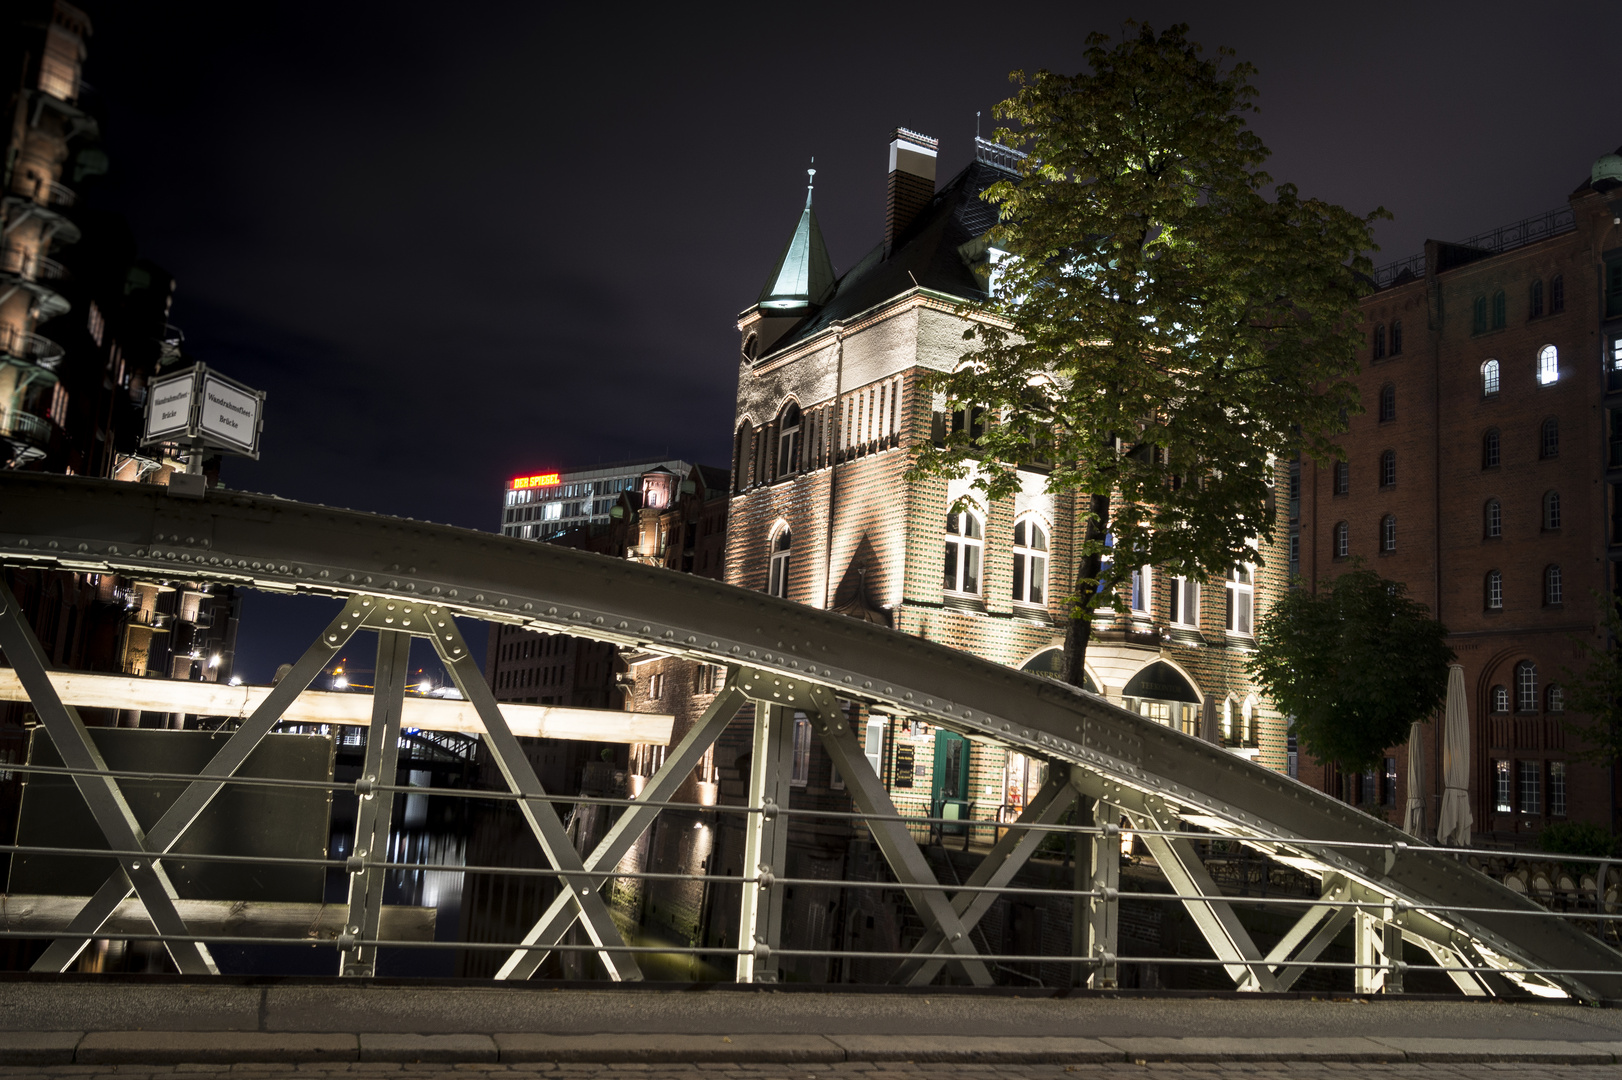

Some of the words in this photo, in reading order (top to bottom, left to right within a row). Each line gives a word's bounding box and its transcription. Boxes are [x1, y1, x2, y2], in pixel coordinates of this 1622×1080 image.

[162, 410, 177, 420] Brücke
[219, 415, 238, 429] Brücke
[514, 477, 529, 489] DER
[529, 473, 560, 487] SPIEGEL
